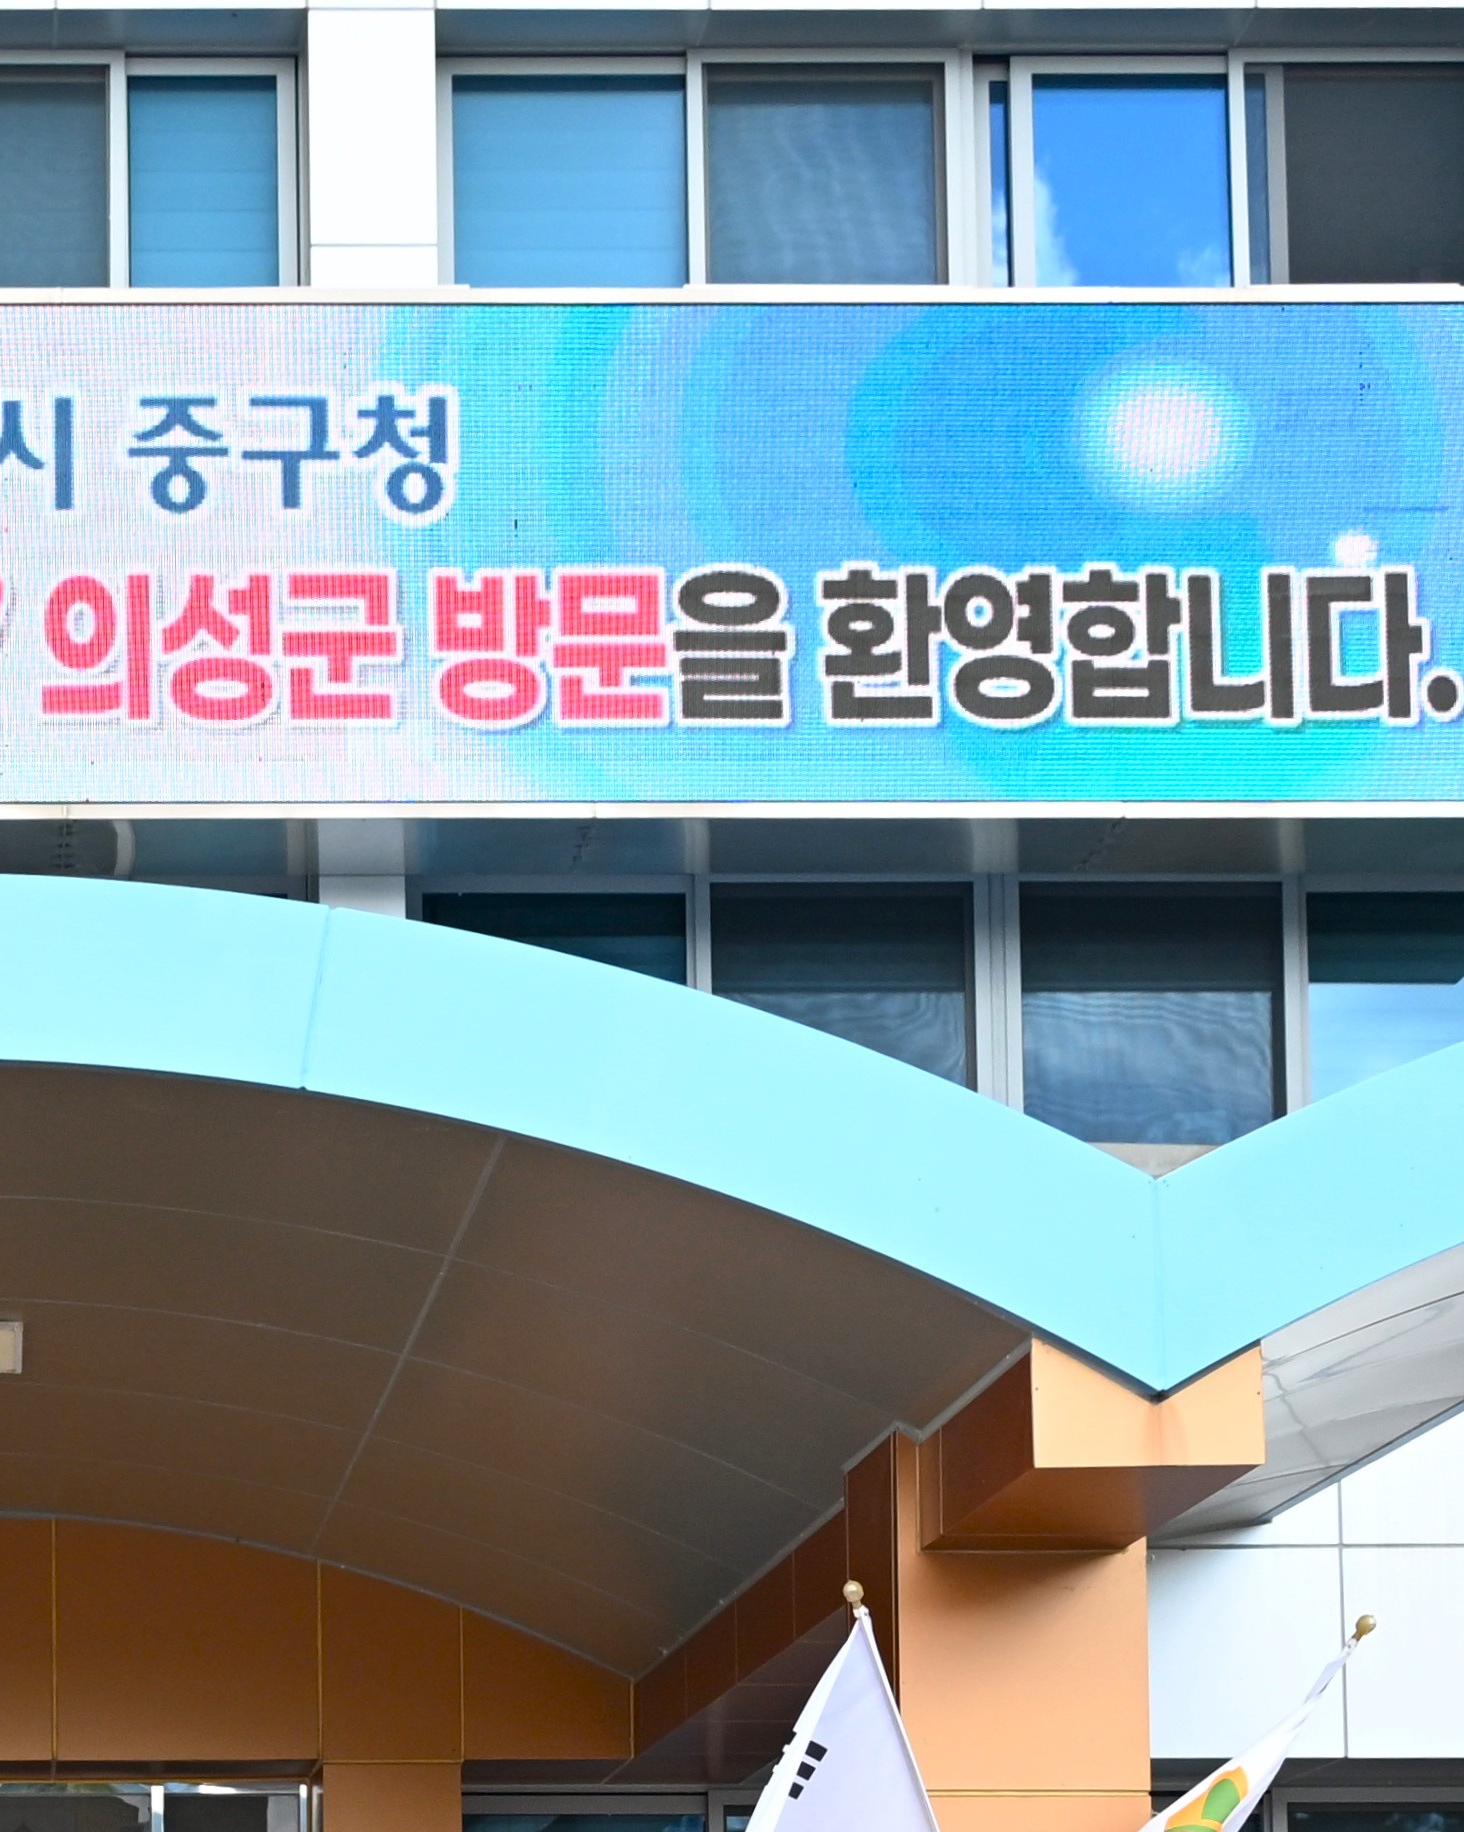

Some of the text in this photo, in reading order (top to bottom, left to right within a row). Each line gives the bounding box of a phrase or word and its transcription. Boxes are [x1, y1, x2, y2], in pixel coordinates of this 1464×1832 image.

[128, 395, 448, 514] 중구청
[41, 573, 400, 721] 의성군
[435, 571, 786, 722] 방문을
[821, 568, 1461, 721] 환영합니다.
